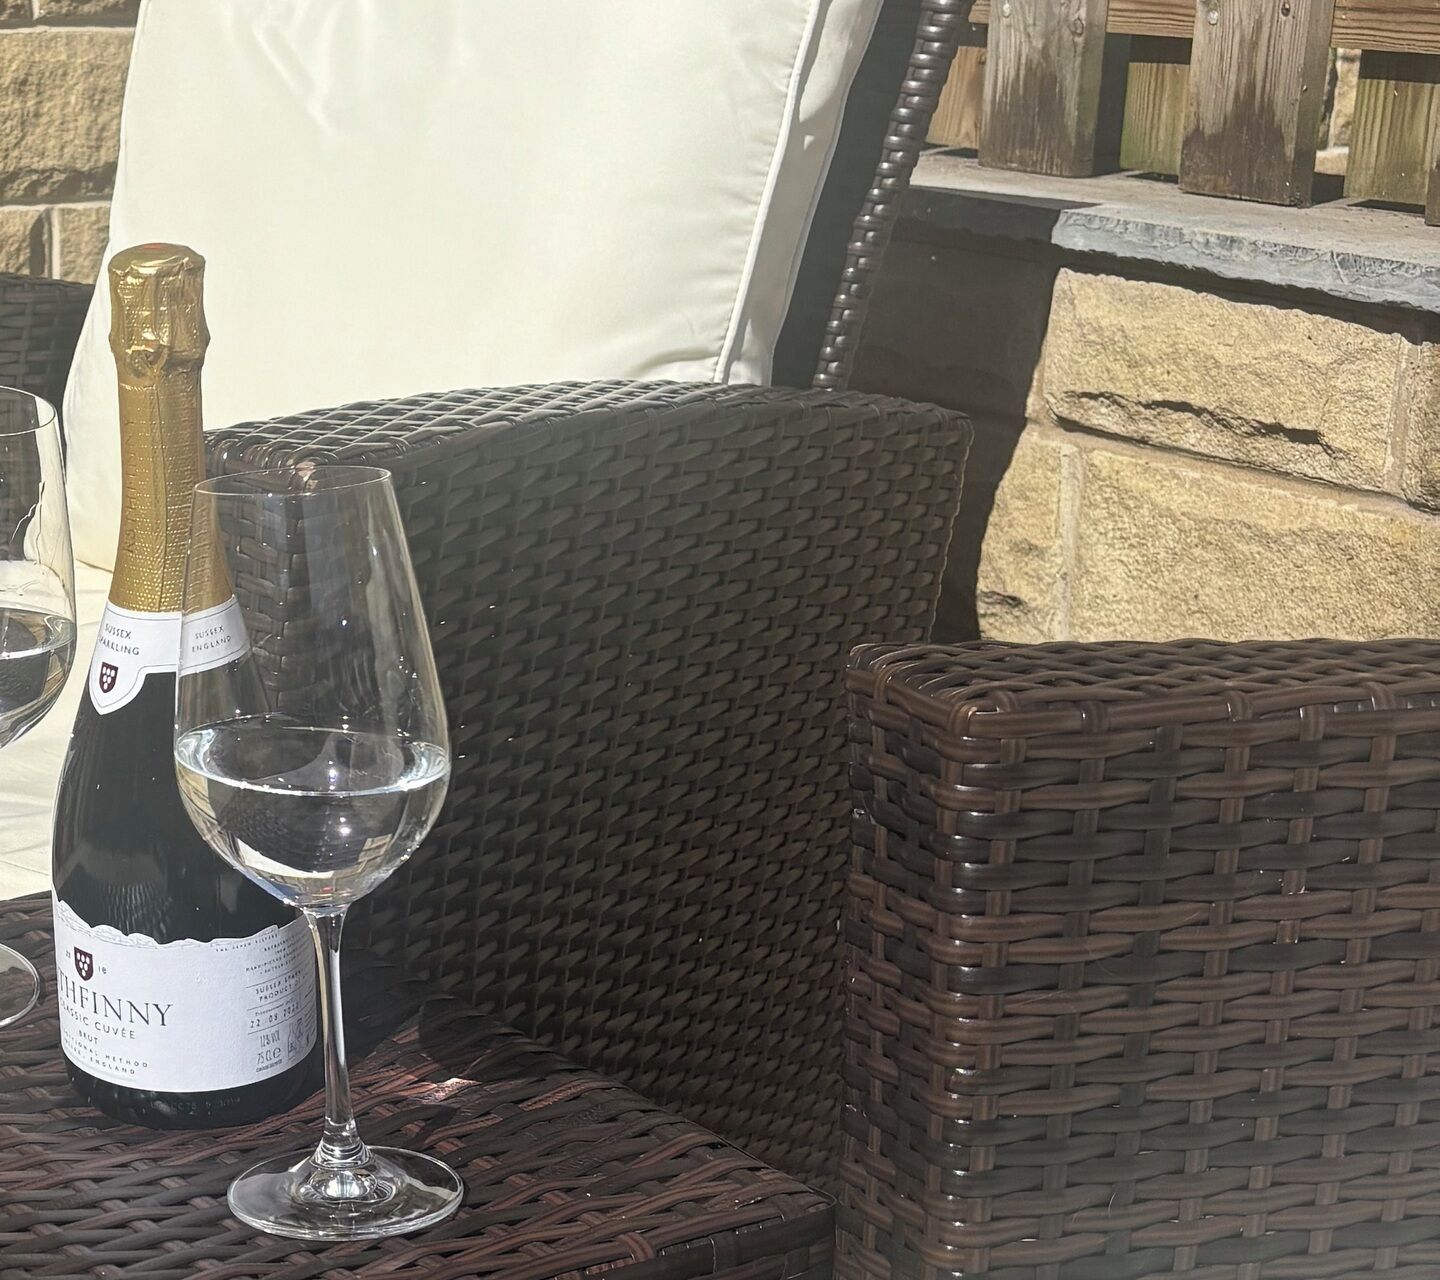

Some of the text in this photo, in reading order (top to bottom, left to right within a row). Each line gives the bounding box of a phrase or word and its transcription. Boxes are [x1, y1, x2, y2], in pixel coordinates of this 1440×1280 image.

[104, 622, 132, 640] SUSSEX
[195, 625, 225, 640] SUSSEX
[191, 635, 232, 653] ENGLAND
[58, 967, 174, 1027] THFINNY
[78, 1030, 99, 1045] BRUT
[94, 1020, 136, 1040] CUVÉE
[90, 1057, 135, 1074] ENGLAND
[105, 1055, 148, 1068] METHOD
